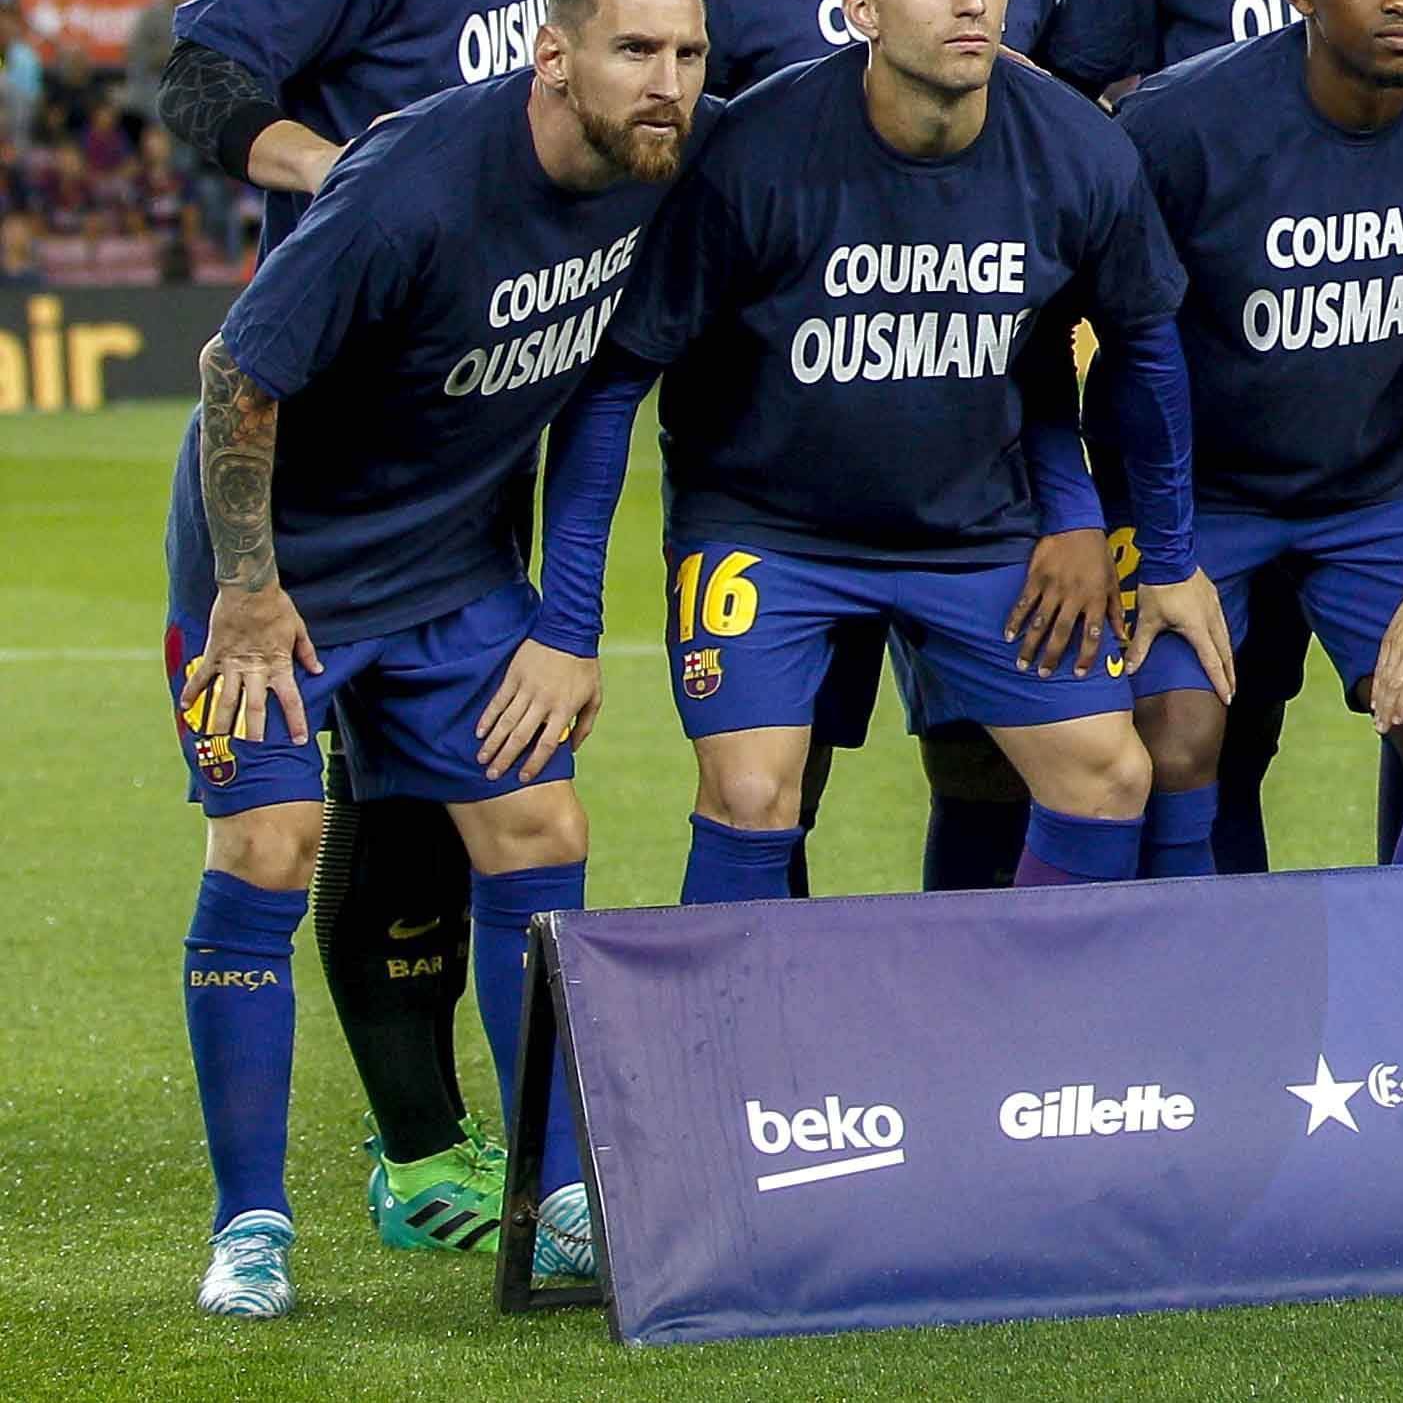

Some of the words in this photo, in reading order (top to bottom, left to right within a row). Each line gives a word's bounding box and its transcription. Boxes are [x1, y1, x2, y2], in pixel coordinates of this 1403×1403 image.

[489, 226, 641, 328] COURAGE
[824, 242, 1025, 297] COURAGE
[444, 287, 624, 396] OUSMAN
[791, 308, 1032, 384] OUSMAN
[675, 551, 763, 643] 16
[190, 969, 279, 992] BARÇA
[387, 956, 442, 979] BAR
[745, 1096, 904, 1154] beko
[999, 1084, 1195, 1139] Gillette
